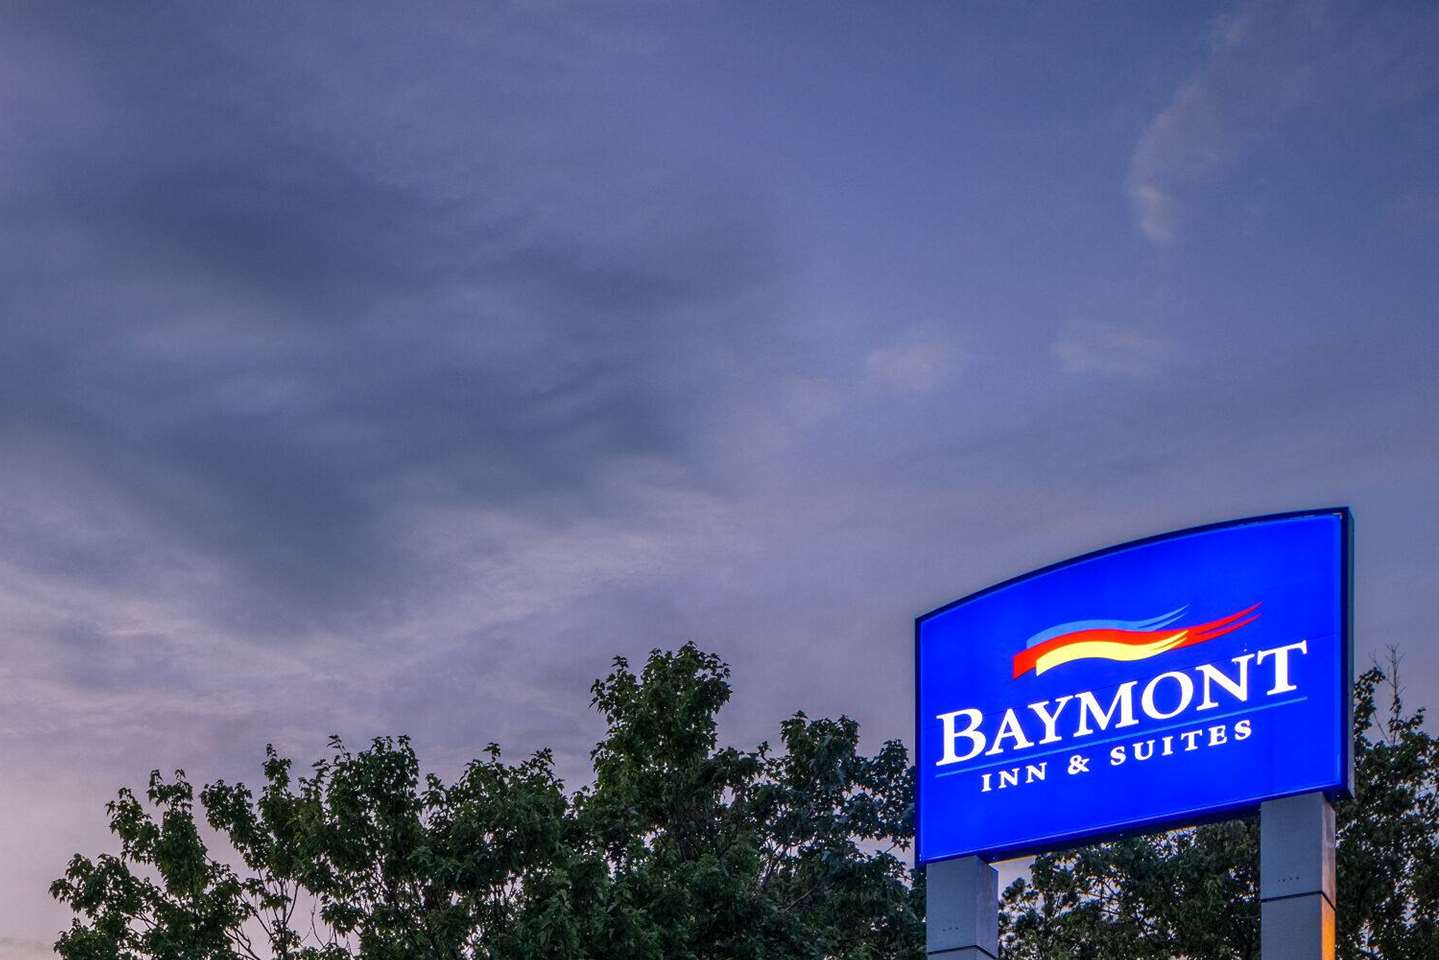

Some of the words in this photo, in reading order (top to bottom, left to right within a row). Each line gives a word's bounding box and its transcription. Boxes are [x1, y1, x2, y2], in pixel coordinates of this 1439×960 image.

[936, 640, 1308, 766] BAYMONT
[981, 762, 1047, 792] INN
[1067, 754, 1090, 775] &
[1110, 720, 1252, 766] SUITES
